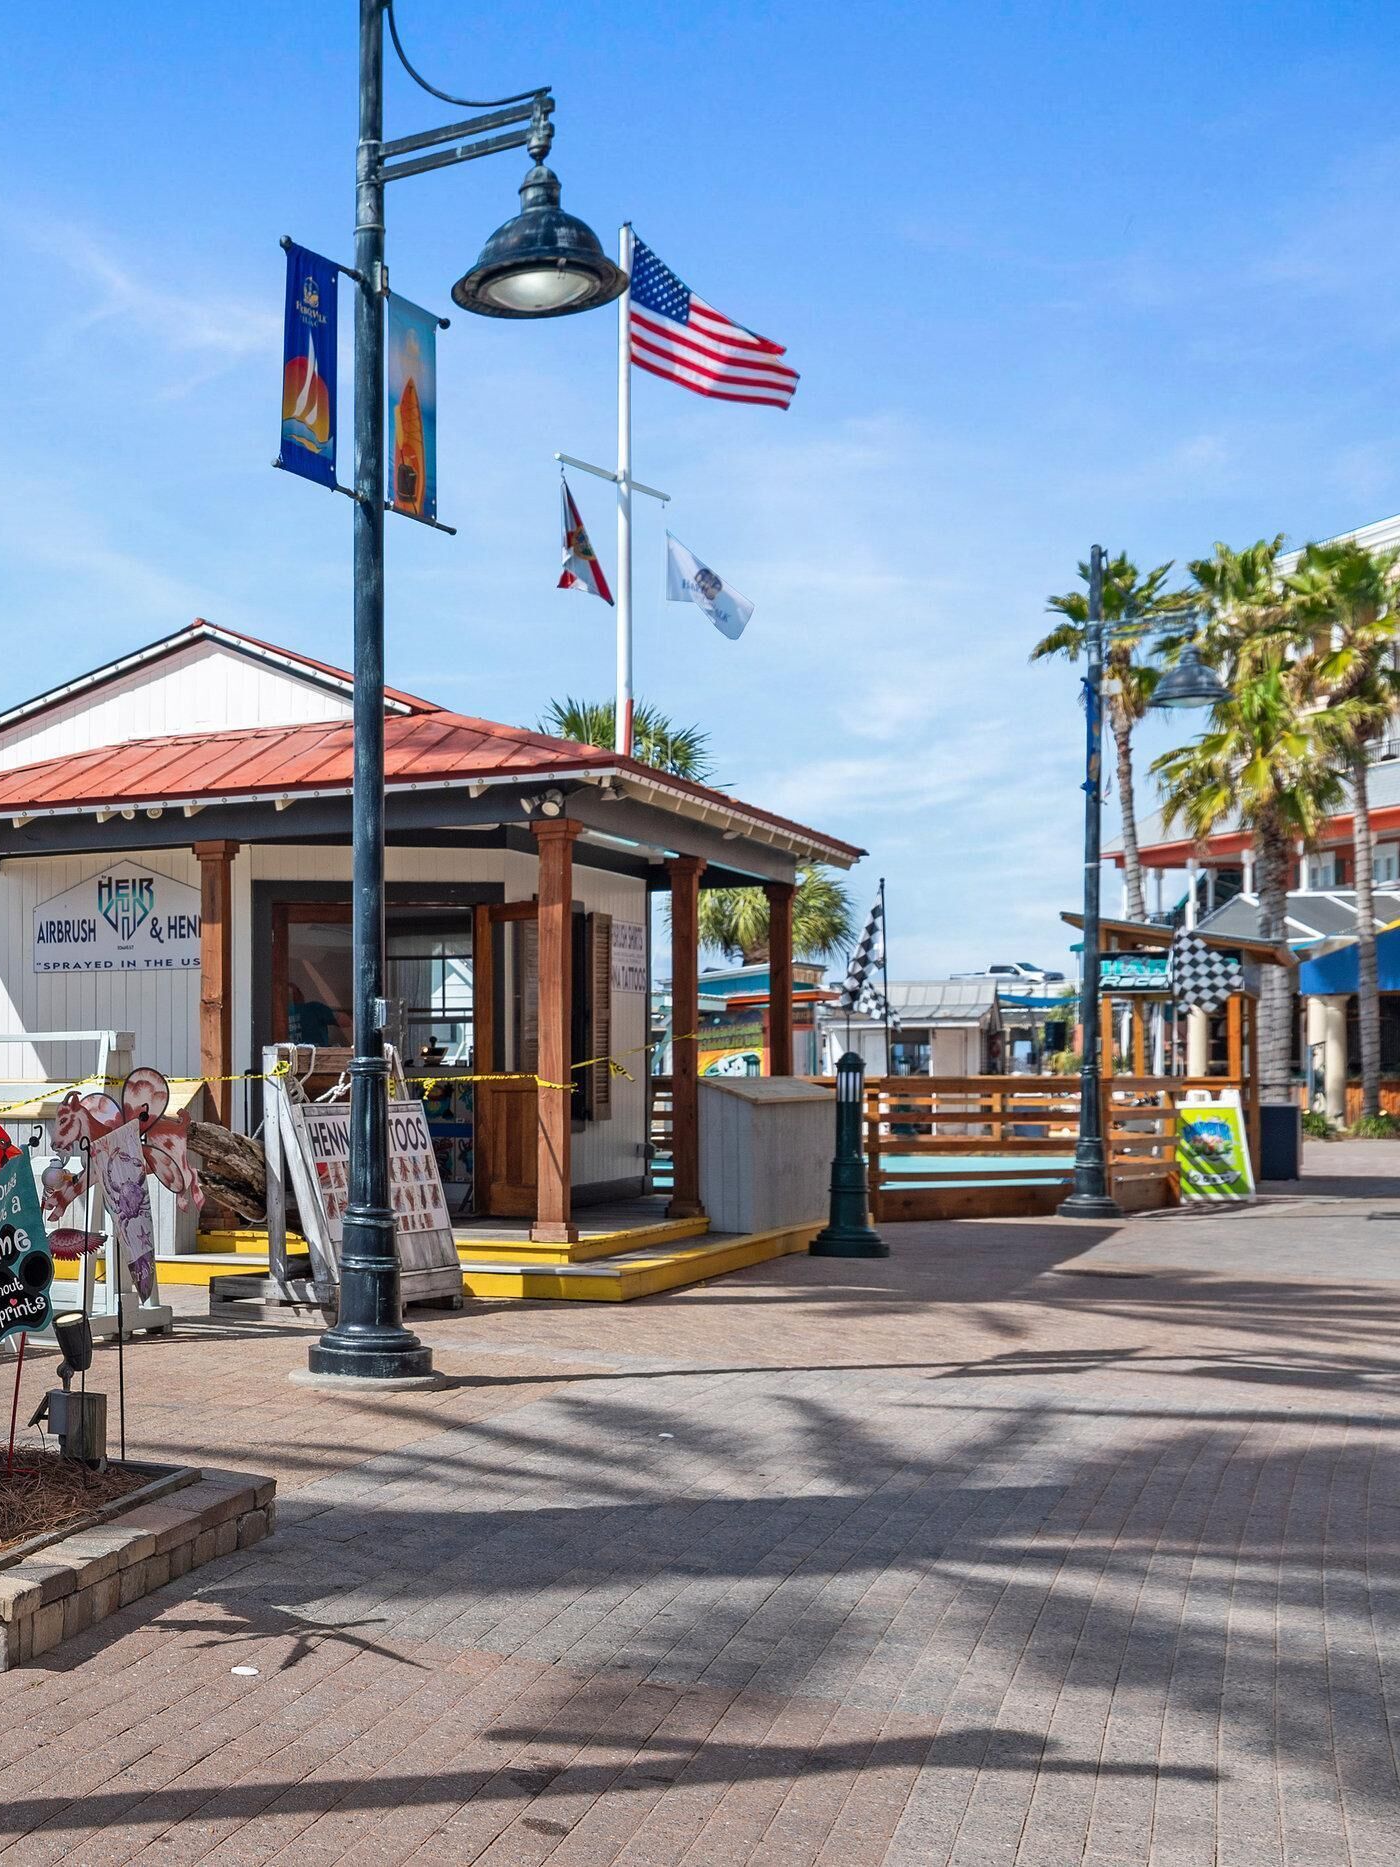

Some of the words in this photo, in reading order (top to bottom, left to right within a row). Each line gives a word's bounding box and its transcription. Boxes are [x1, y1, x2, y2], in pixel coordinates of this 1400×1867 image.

[37, 918, 96, 944] AIRBRUSH
[150, 917, 164, 944] &
[168, 914, 202, 938] HEN
[121, 960, 136, 968] IN
[144, 958, 173, 968] THE
[12, 1195, 22, 1214] a
